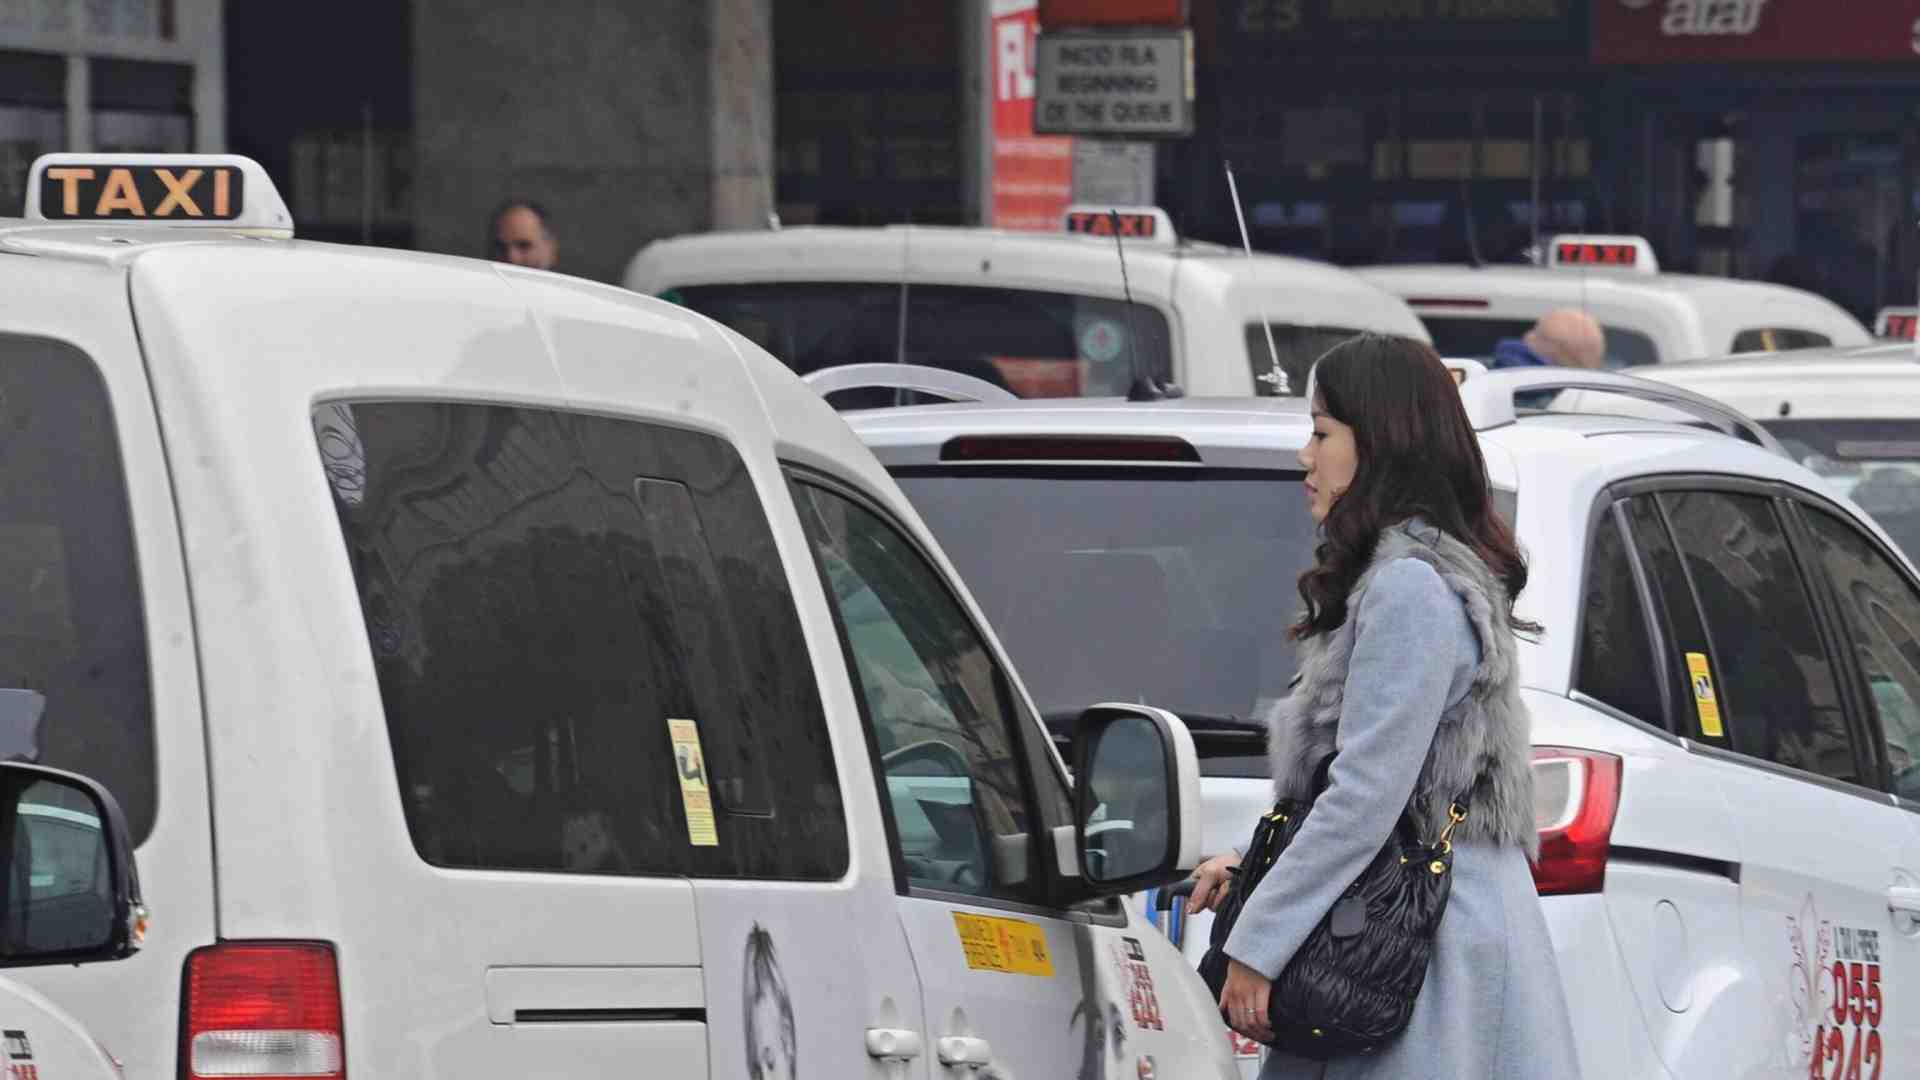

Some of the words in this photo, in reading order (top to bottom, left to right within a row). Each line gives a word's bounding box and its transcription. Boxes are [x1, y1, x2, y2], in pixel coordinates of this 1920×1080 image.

[1058, 74, 1159, 95] BEGINNING
[1045, 102, 1067, 124] OF
[1075, 102, 1105, 124] THE
[1112, 102, 1174, 124] QUEUE
[47, 168, 231, 217] TAXI
[1071, 213, 1153, 237] TAXI
[1560, 244, 1634, 265] TAXI
[1832, 960, 1883, 1029] 055
